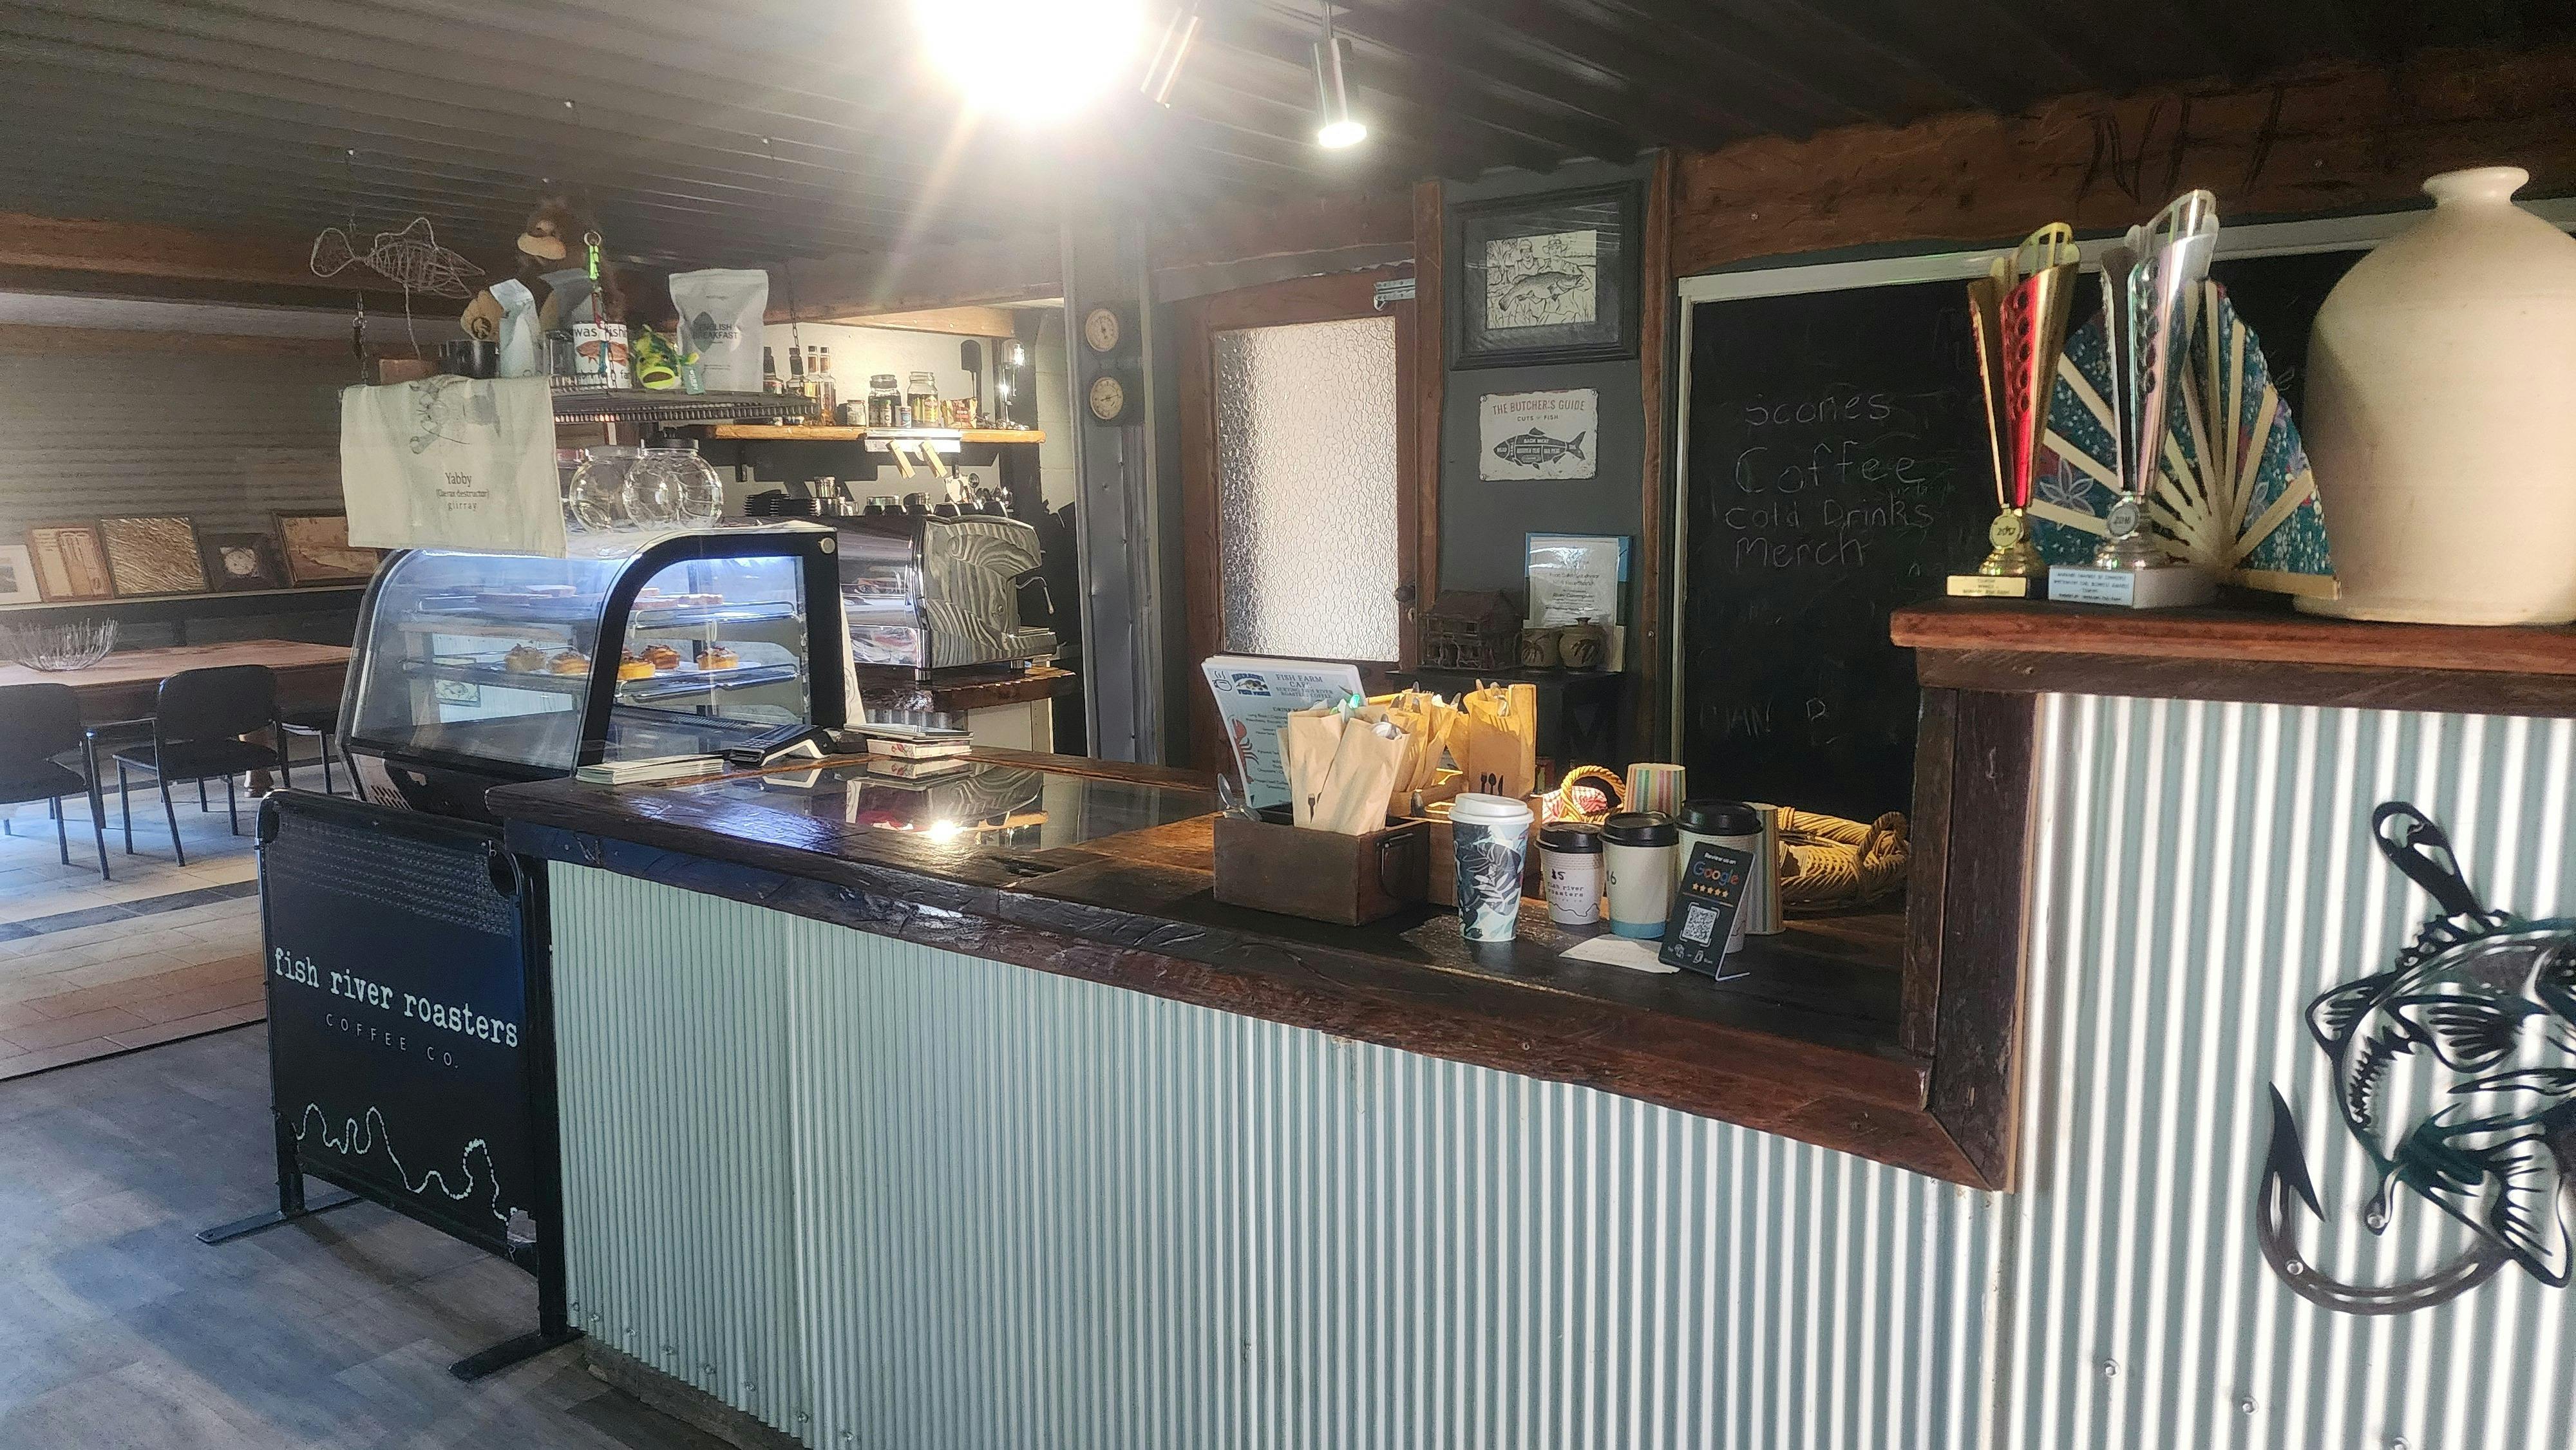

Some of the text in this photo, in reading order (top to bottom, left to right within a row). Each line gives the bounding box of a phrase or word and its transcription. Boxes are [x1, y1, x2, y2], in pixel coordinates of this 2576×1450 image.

[574, 327, 598, 337] was
[1493, 399, 1586, 415] THE BUTCHER'S GUIDE
[444, 471, 471, 487] Yabby
[1736, 440, 1926, 493] Coffee
[1824, 492, 1933, 529] Drinks
[1736, 532, 1868, 568] Merch
[1692, 862, 1739, 886] Google
[274, 947, 518, 1048] fish river roasters
[326, 1013, 459, 1069] COFFEE CO.
